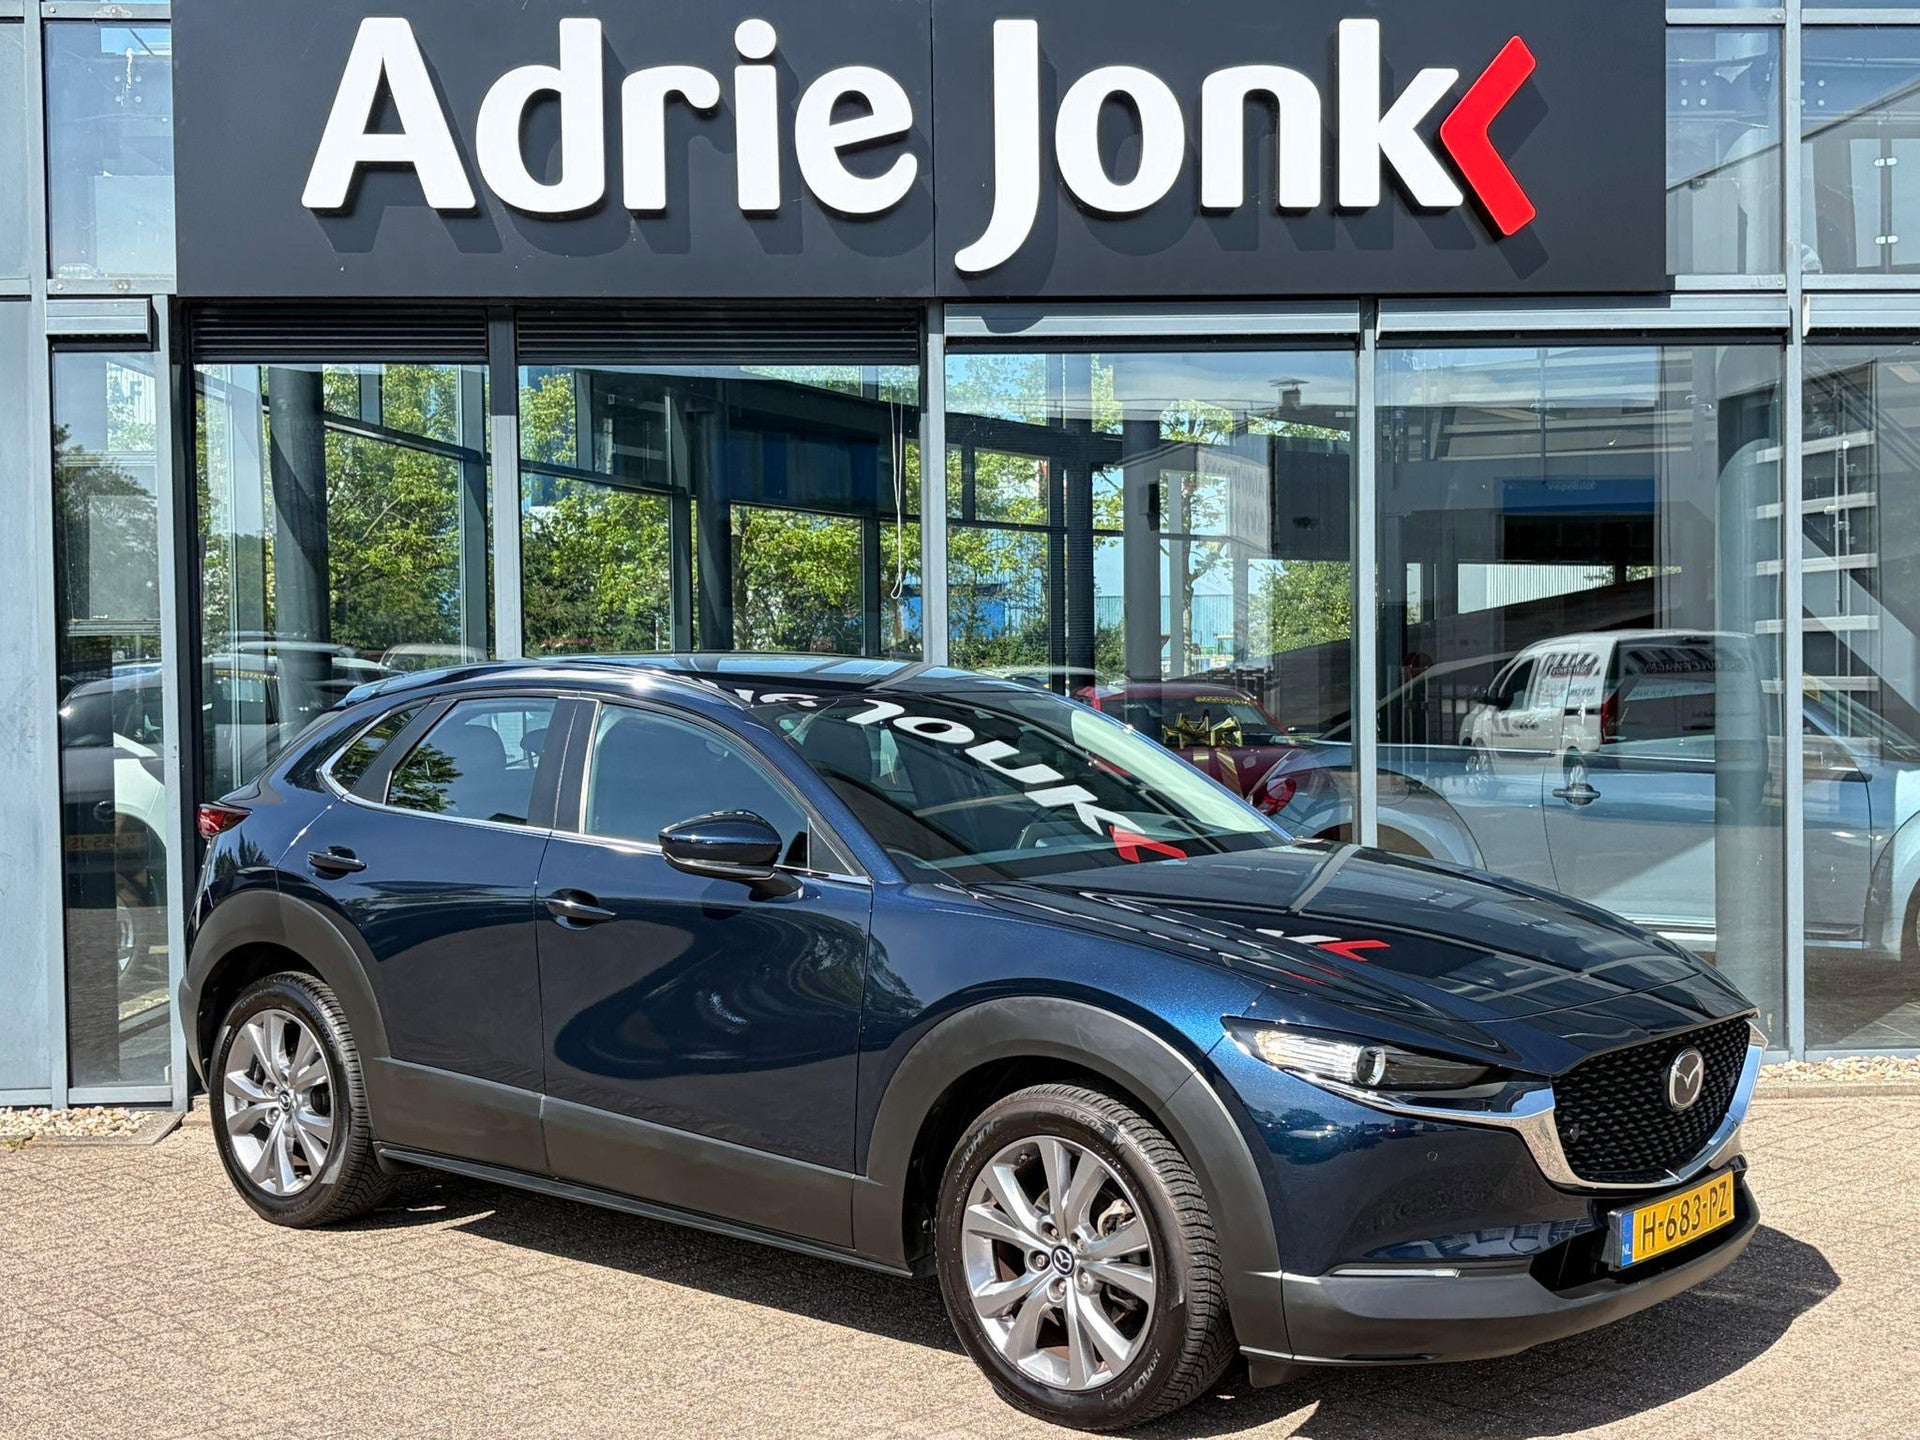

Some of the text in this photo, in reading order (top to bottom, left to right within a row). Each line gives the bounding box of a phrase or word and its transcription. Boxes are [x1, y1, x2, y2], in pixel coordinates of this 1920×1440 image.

[301, 17, 1465, 272] Adrie Jonk
[1621, 1243, 1632, 1256] NL
[1641, 1181, 1728, 1252] H-683-PZ
